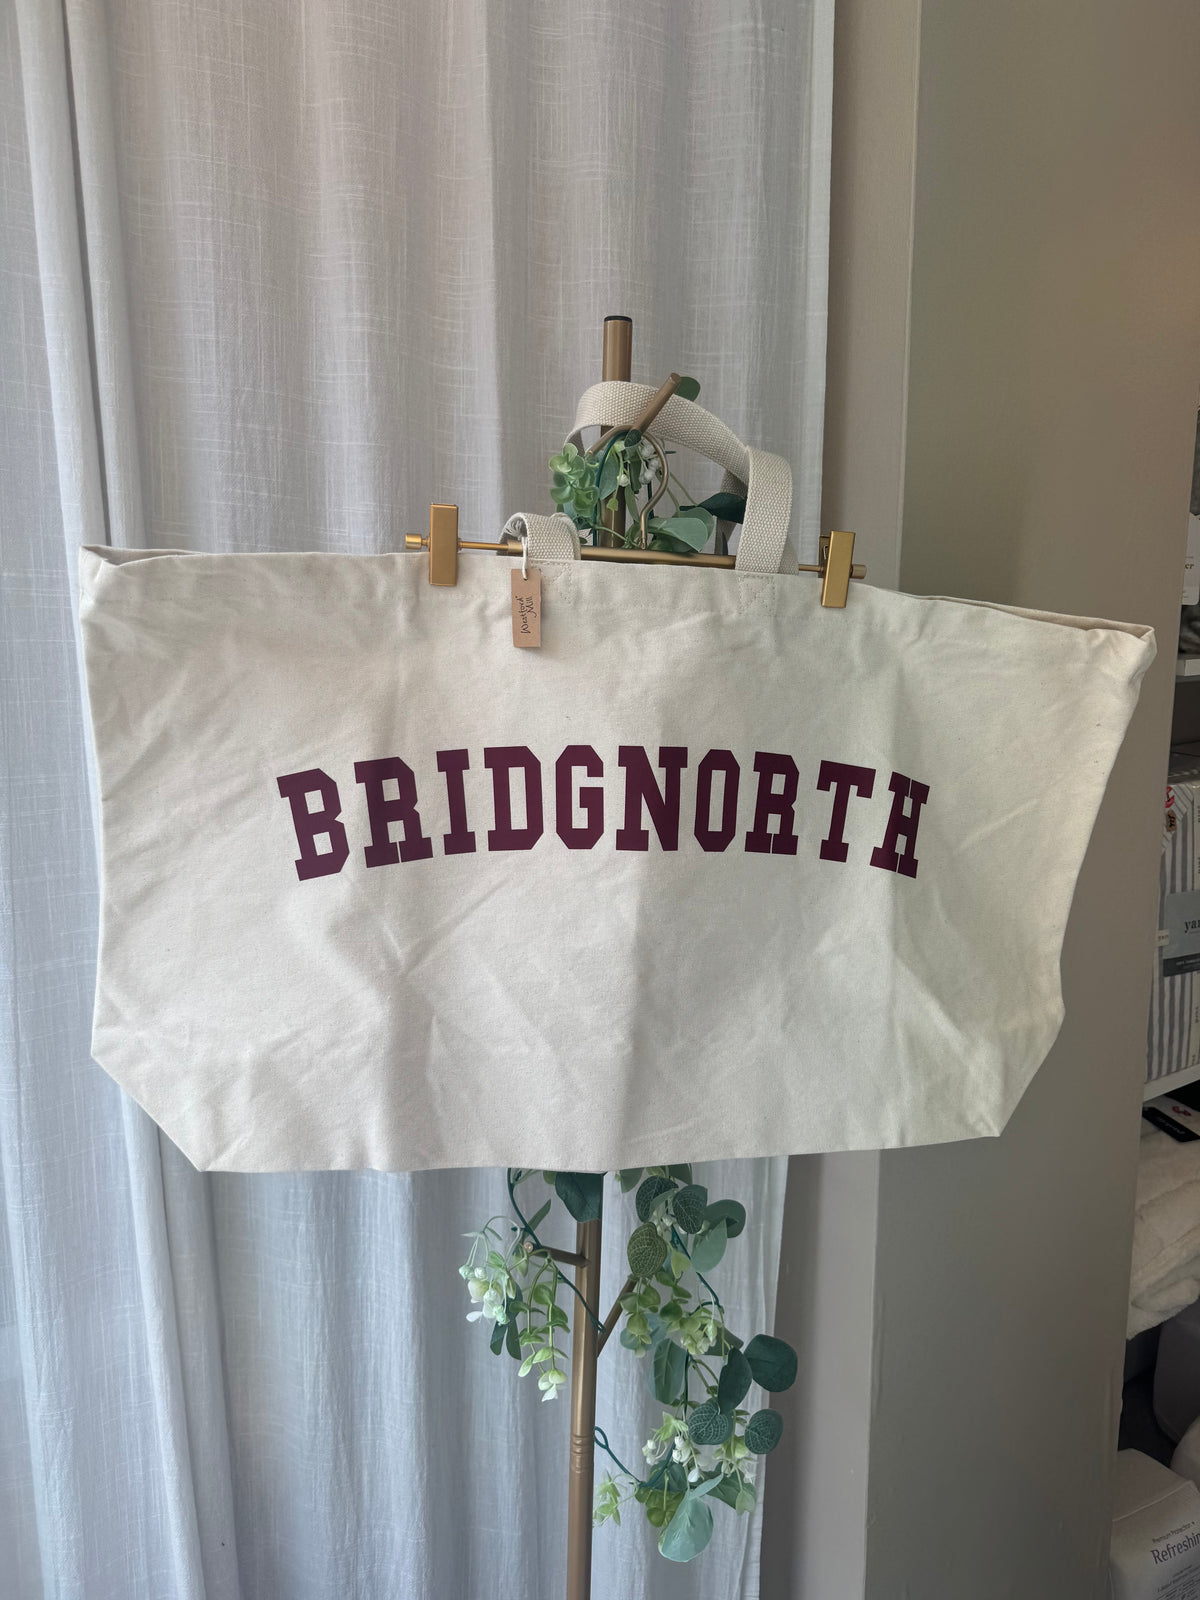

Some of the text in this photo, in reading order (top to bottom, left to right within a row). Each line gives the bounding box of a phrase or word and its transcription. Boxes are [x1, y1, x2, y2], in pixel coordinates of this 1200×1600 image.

[516, 597, 531, 634] Westford
[525, 596, 537, 618] Mill
[276, 744, 931, 881] BRIDGNORTH
